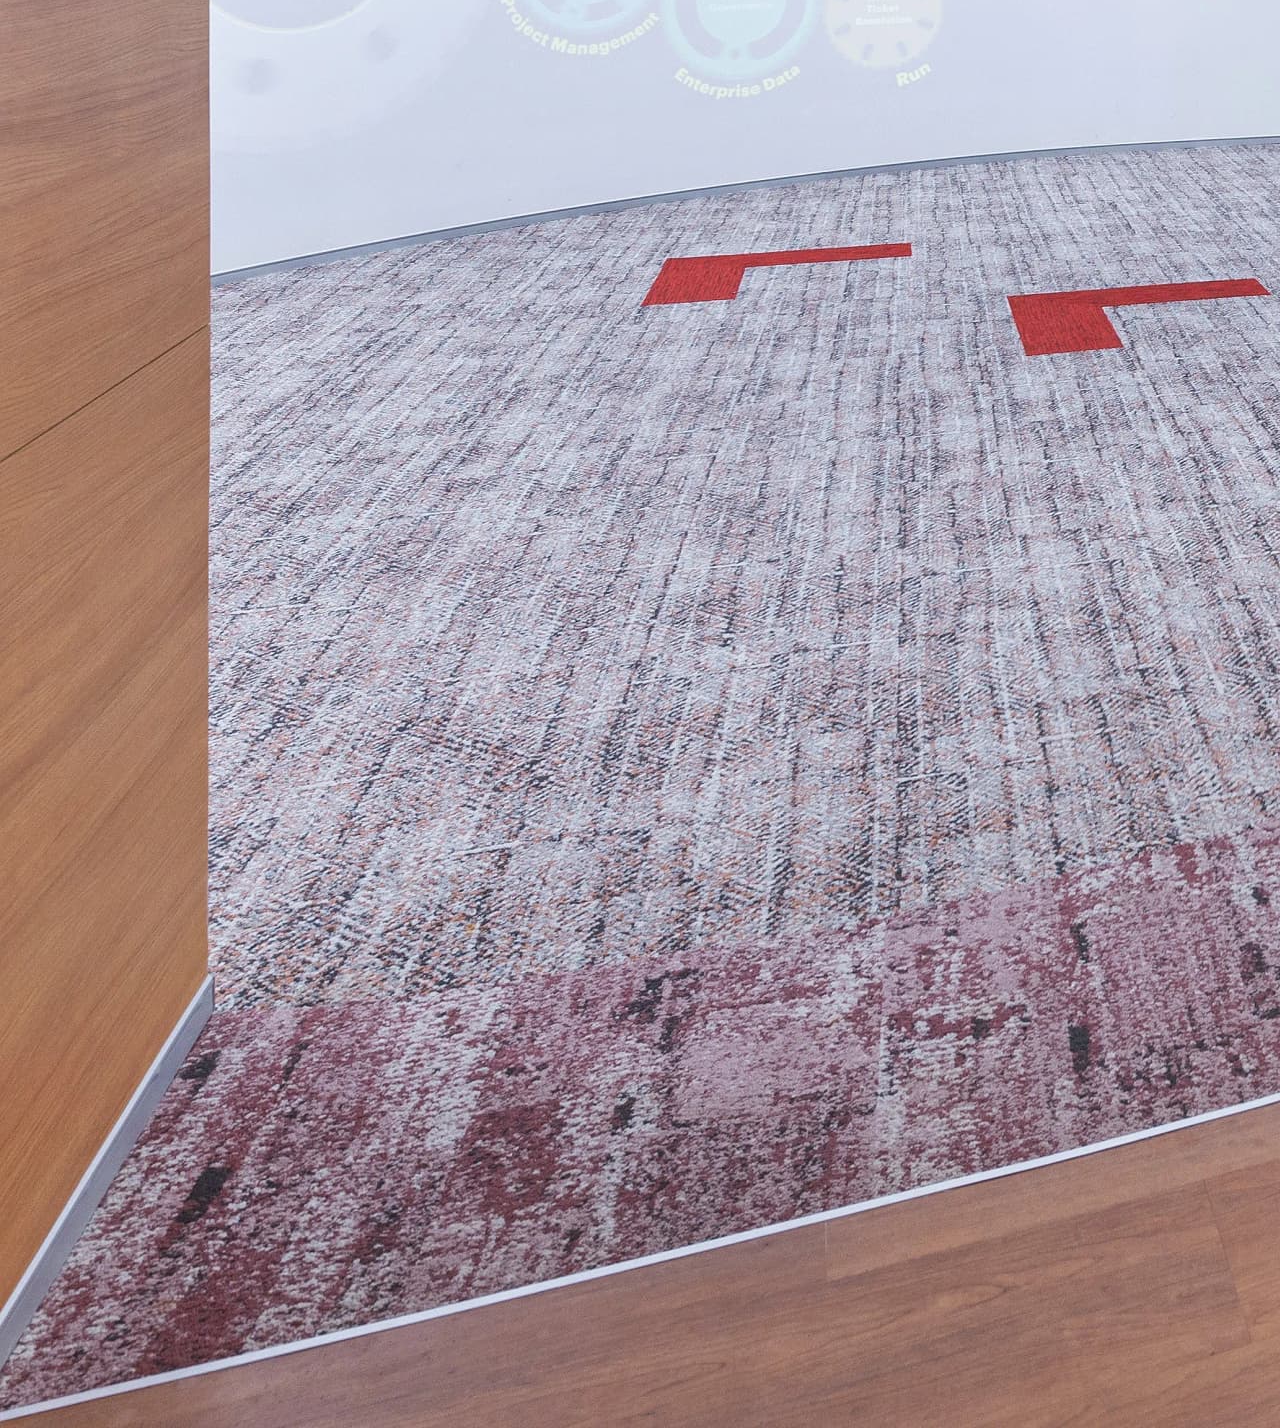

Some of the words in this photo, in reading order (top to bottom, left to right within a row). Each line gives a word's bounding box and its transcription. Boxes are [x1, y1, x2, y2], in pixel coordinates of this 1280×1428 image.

[550, 12, 661, 56] Management
[673, 66, 762, 100] Enterprise
[762, 64, 802, 93] Data
[895, 62, 933, 88] Run
